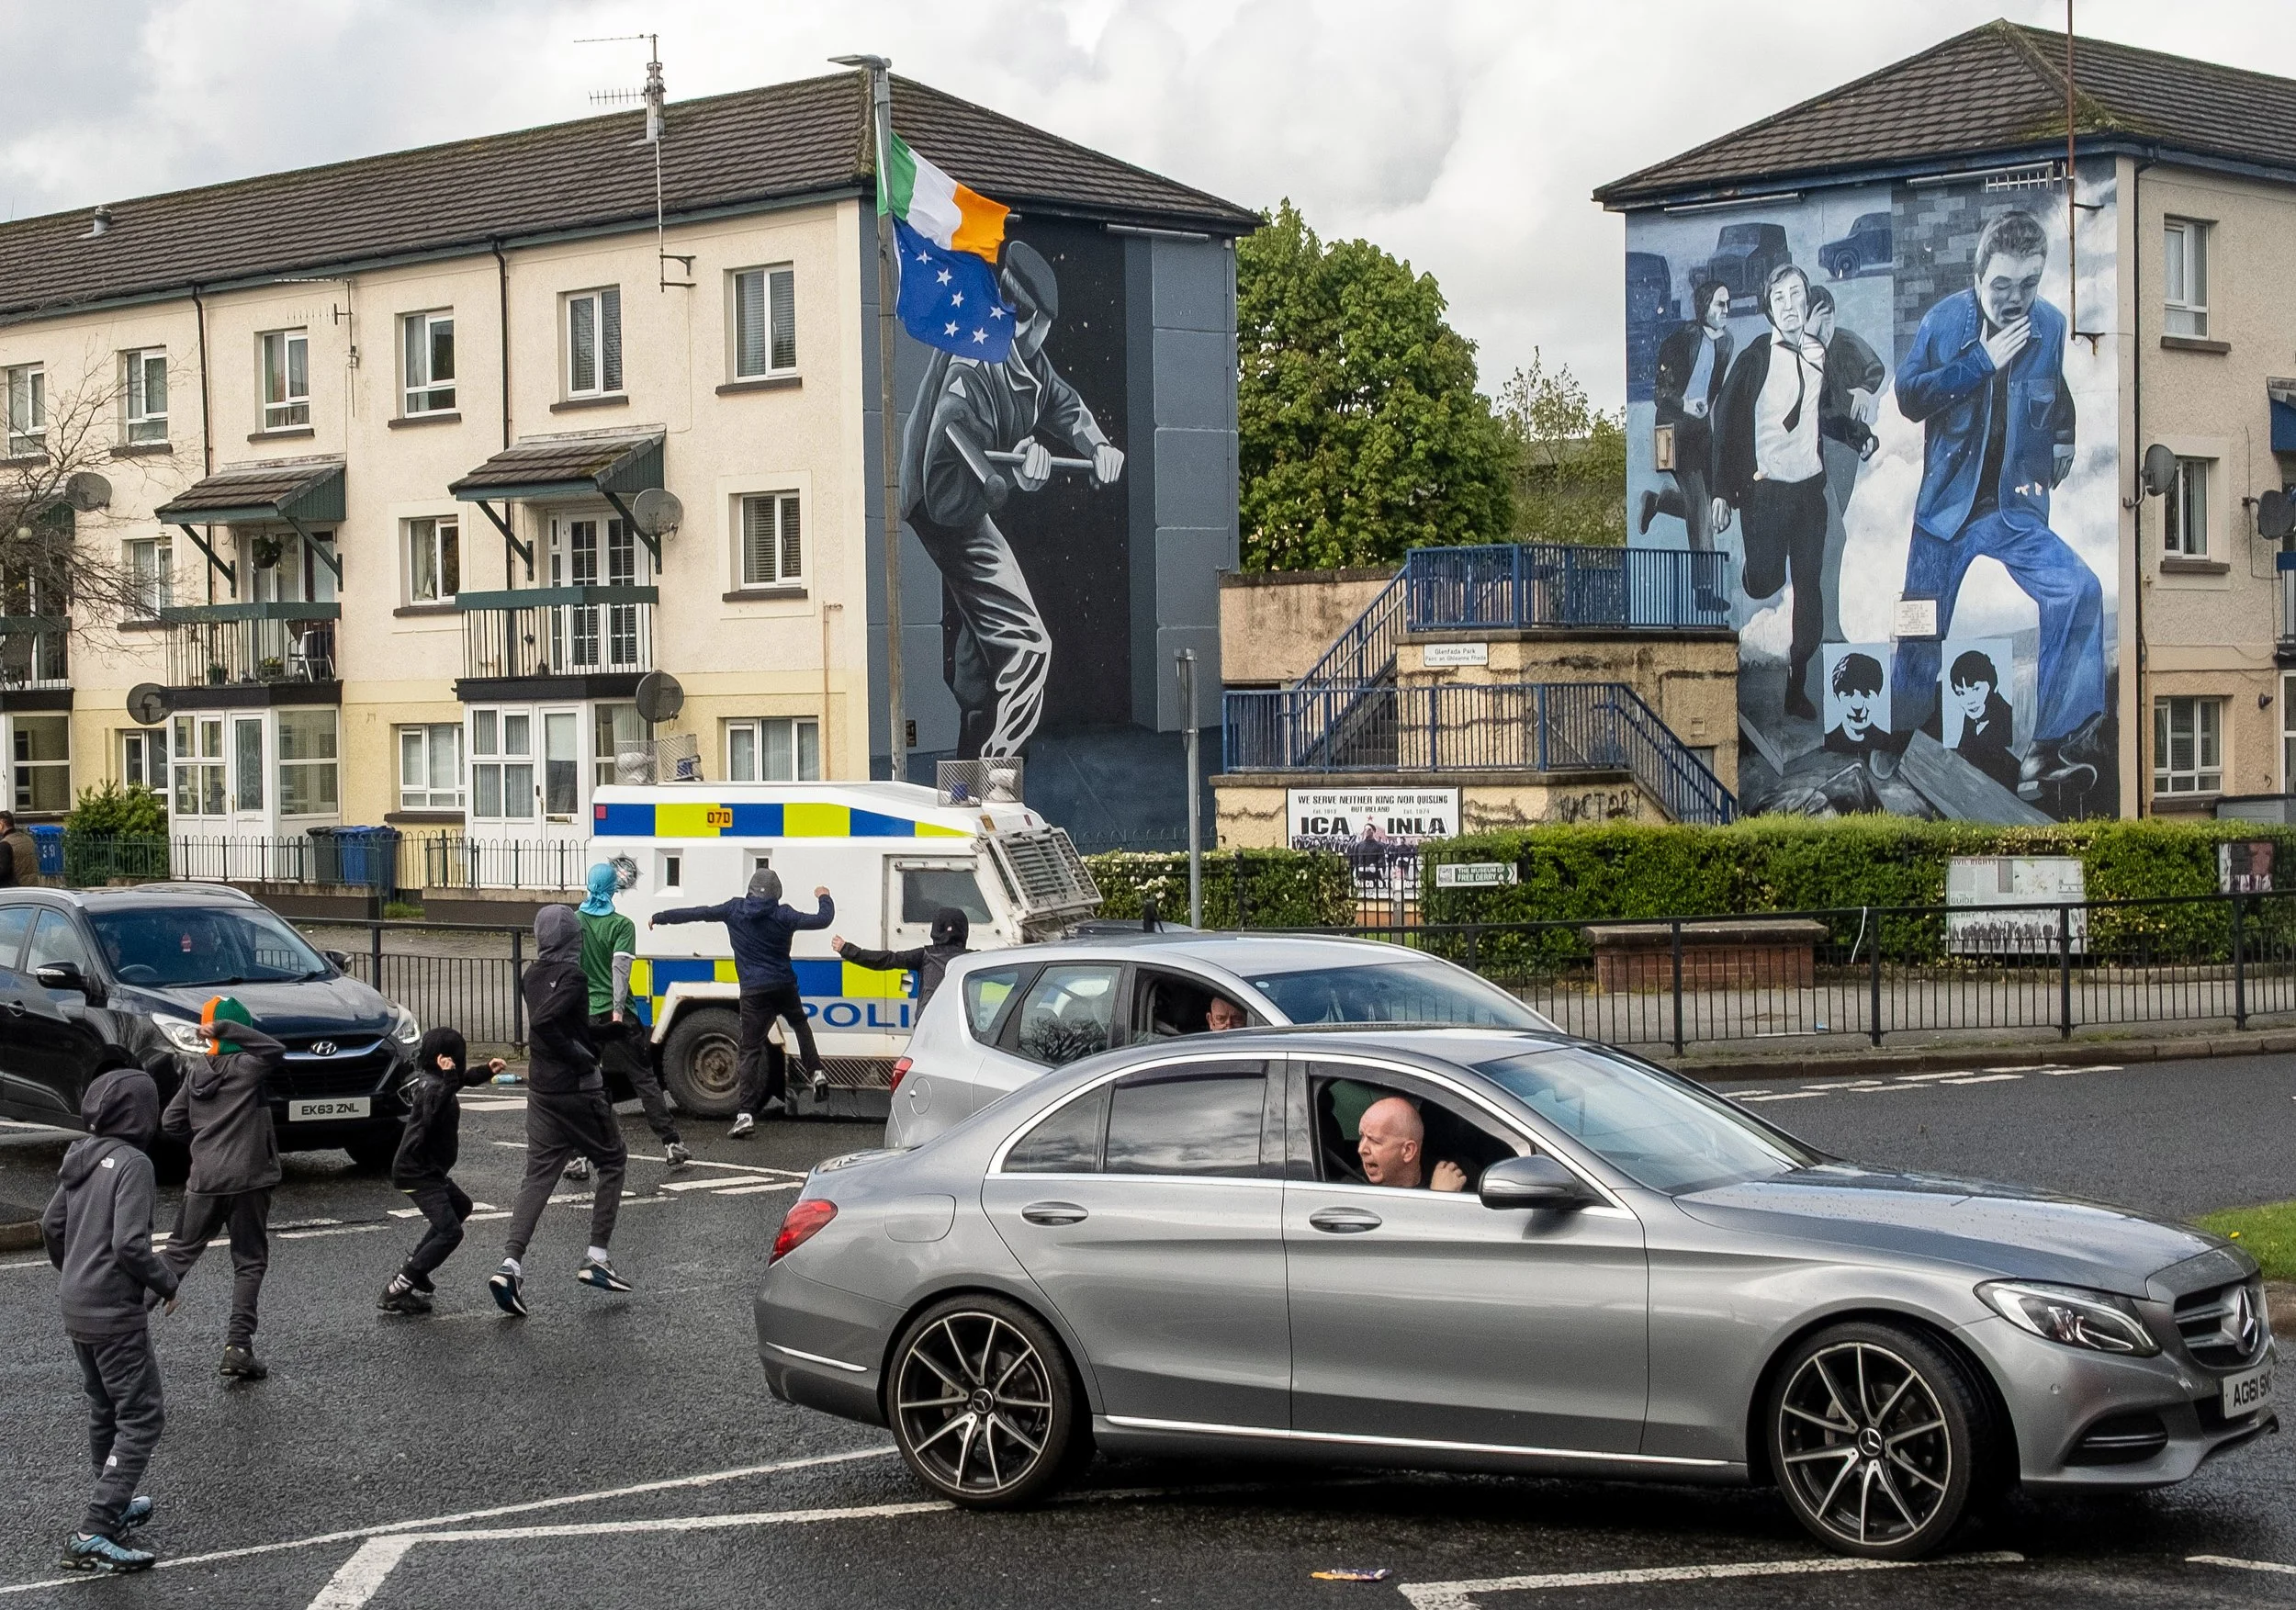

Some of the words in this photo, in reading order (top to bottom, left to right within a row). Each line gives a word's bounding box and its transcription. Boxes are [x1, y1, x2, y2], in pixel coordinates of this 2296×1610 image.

[1298, 795, 1310, 805] WE
[1312, 795, 1337, 805] SERVE
[1339, 795, 1373, 805] NEITHER
[1375, 795, 1394, 805] KING
[1397, 795, 1414, 805] NOR
[1416, 795, 1448, 805] QUISLING
[1300, 816, 1350, 835] ICA
[1387, 817, 1447, 835] INLA
[1458, 873, 1474, 882] FREE
[1475, 873, 1496, 881] DERRY
[301, 1105, 333, 1115] EK63
[336, 1103, 359, 1113] ZNL
